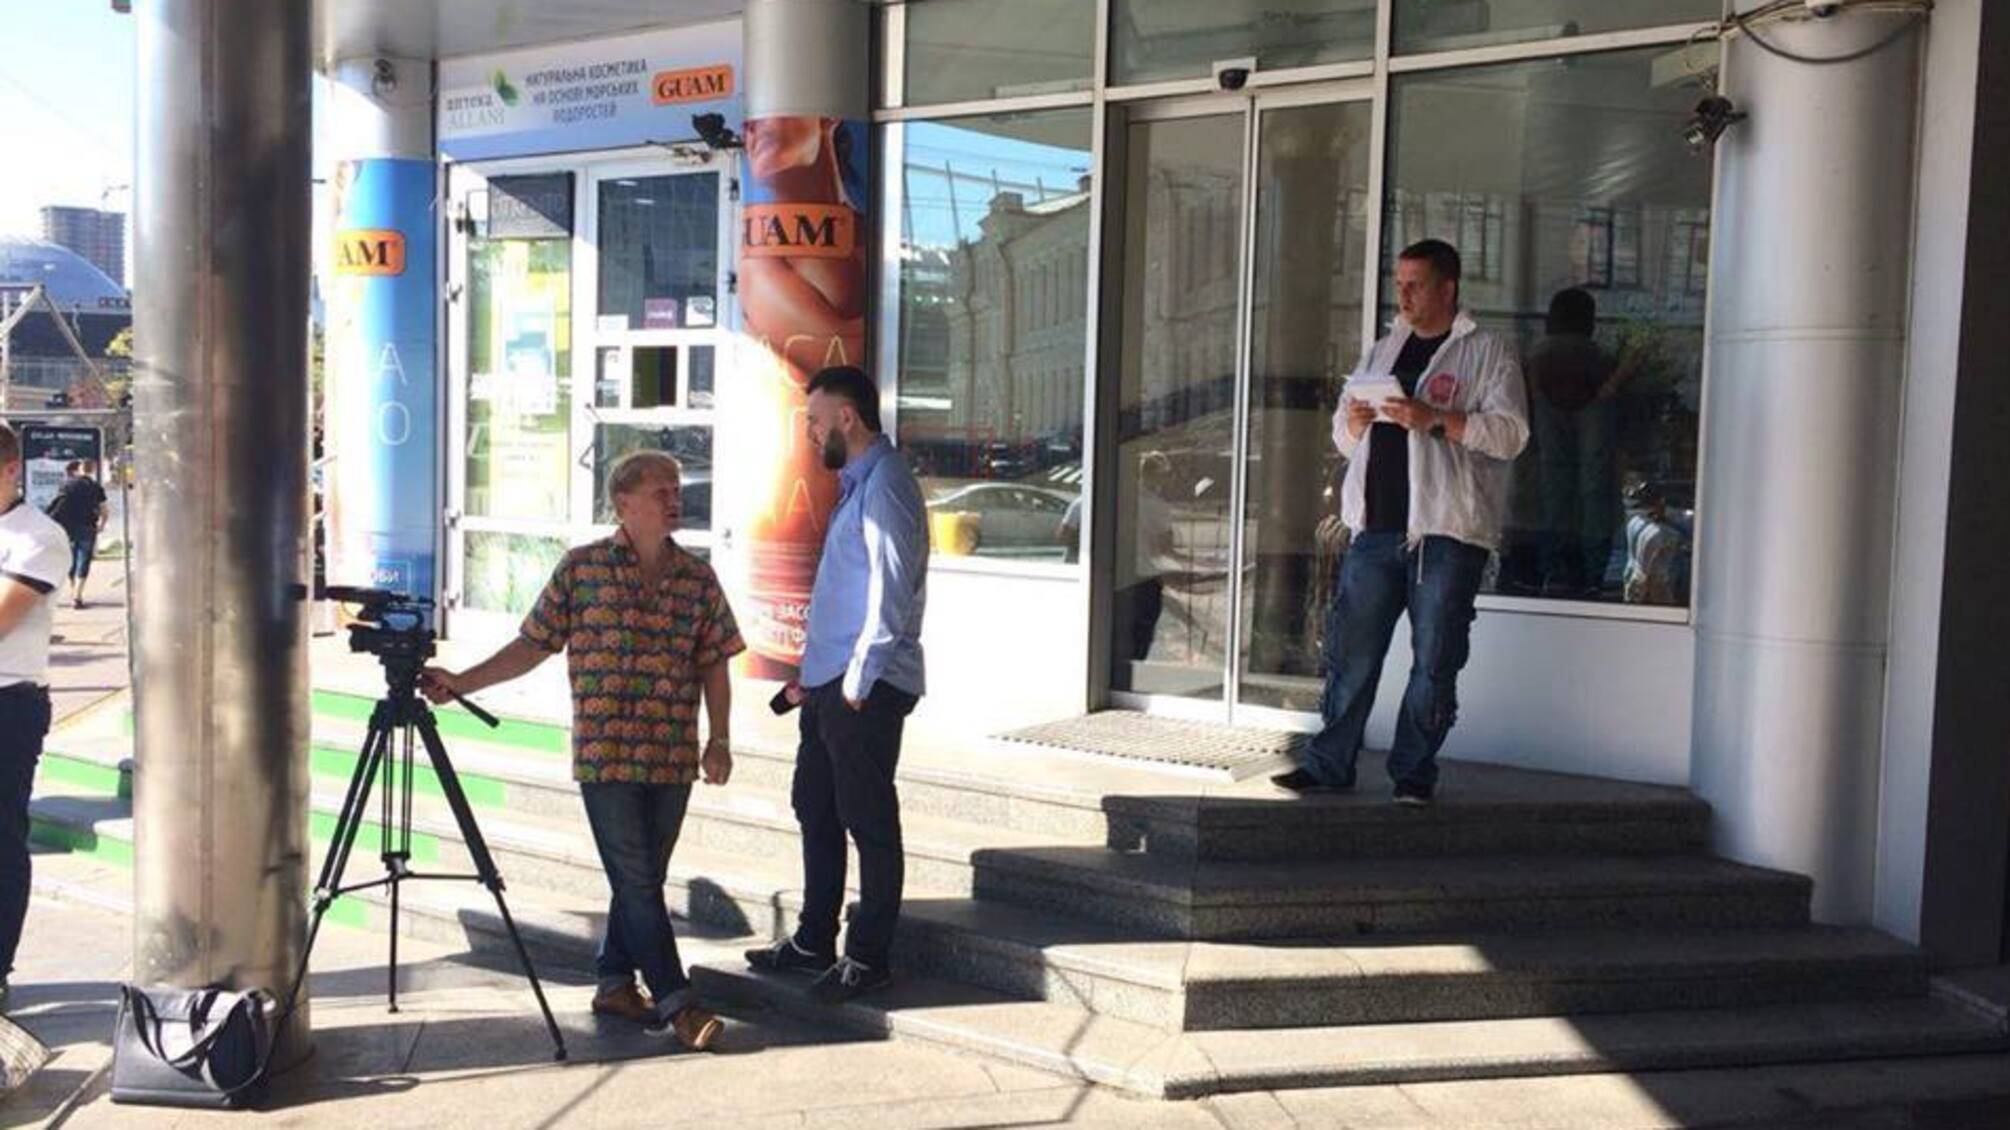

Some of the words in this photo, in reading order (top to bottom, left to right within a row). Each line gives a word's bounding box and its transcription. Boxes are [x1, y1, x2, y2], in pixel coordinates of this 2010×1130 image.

[588, 58, 647, 81] КОСМЕТИКА
[586, 80, 640, 100] МОРСЬКИХ
[657, 74, 726, 99] GUAM
